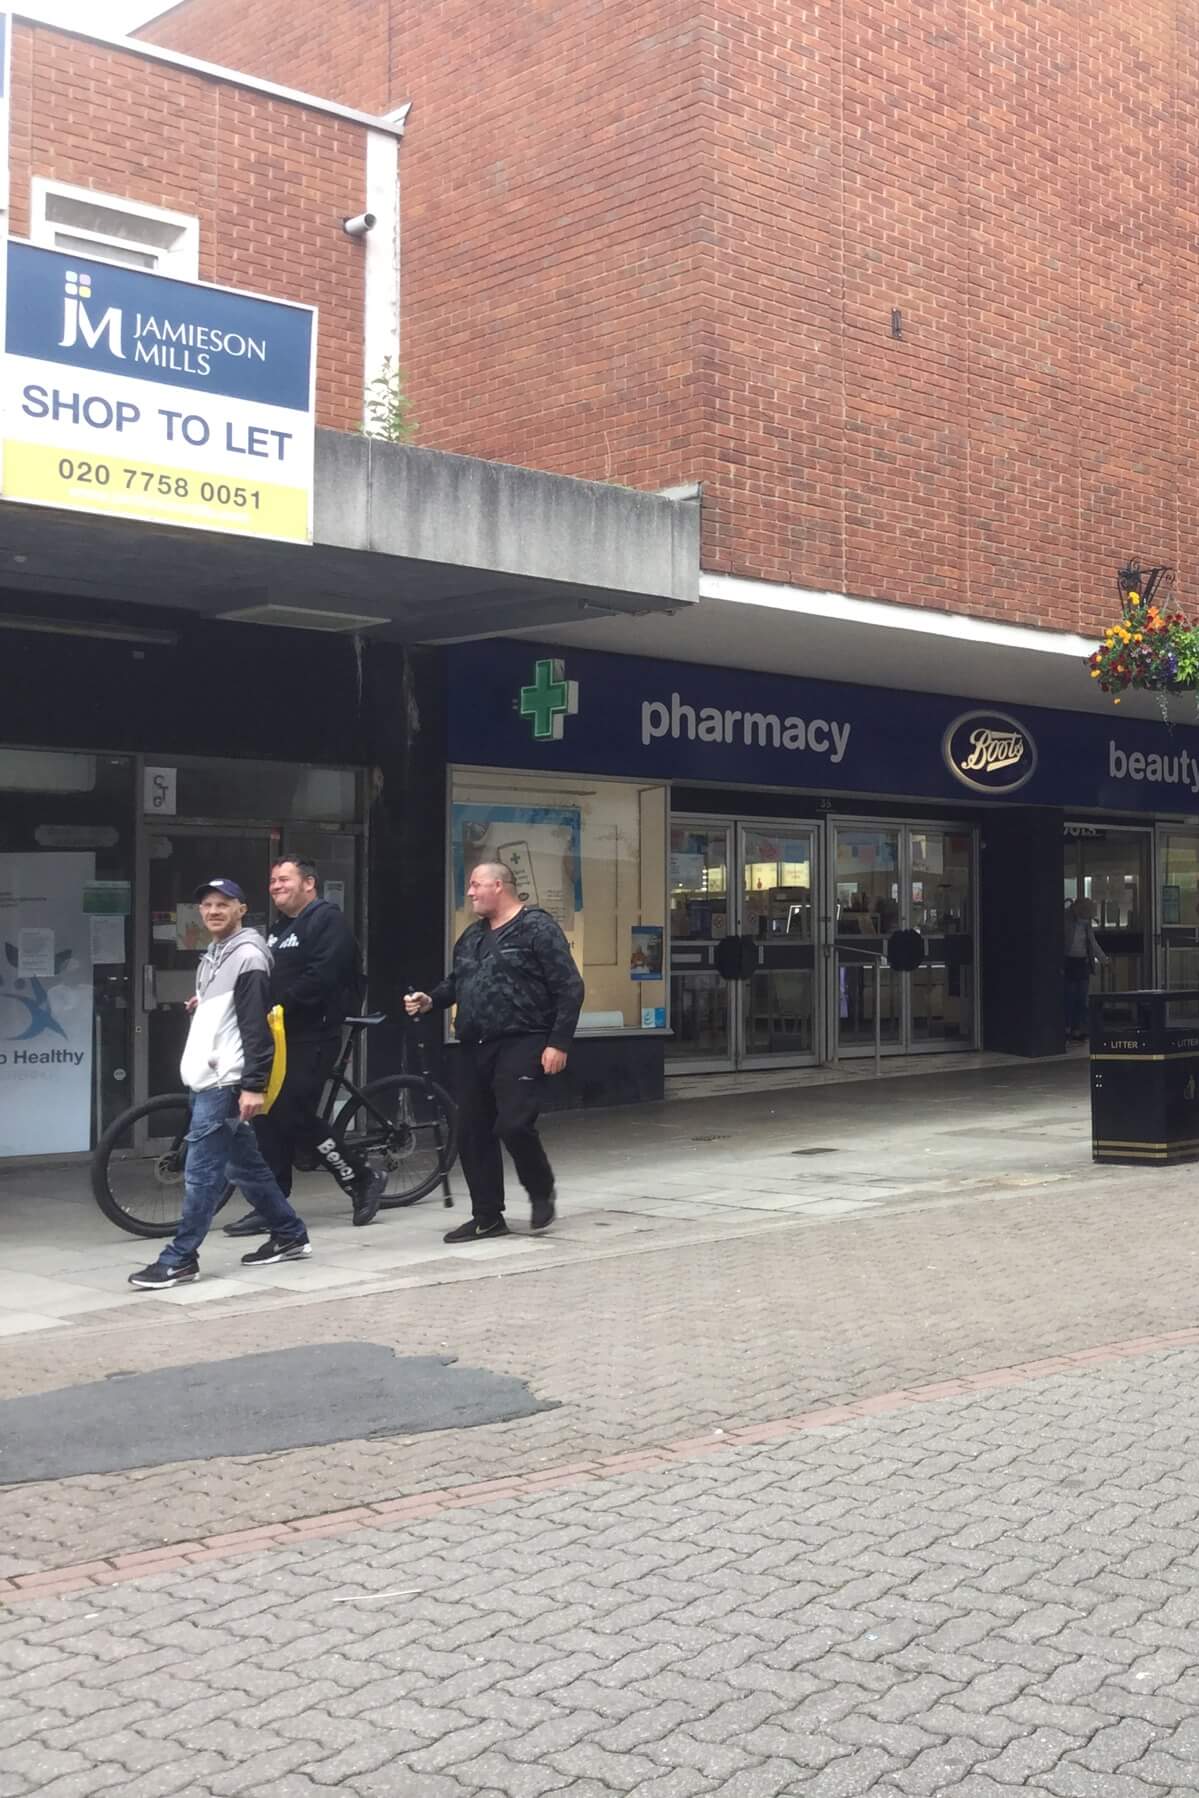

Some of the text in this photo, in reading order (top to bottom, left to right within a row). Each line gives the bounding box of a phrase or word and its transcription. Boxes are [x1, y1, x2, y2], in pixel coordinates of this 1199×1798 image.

[133, 313, 266, 362] JAMIESON
[134, 340, 211, 376] MILLS
[22, 384, 292, 461] SHOP TO LET
[58, 458, 260, 510] 020 7758 0051
[641, 692, 851, 764] pharmacy
[961, 728, 1024, 772] Boots
[13, 1049, 85, 1066] Healthy
[1110, 1040, 1138, 1049] LITTER
